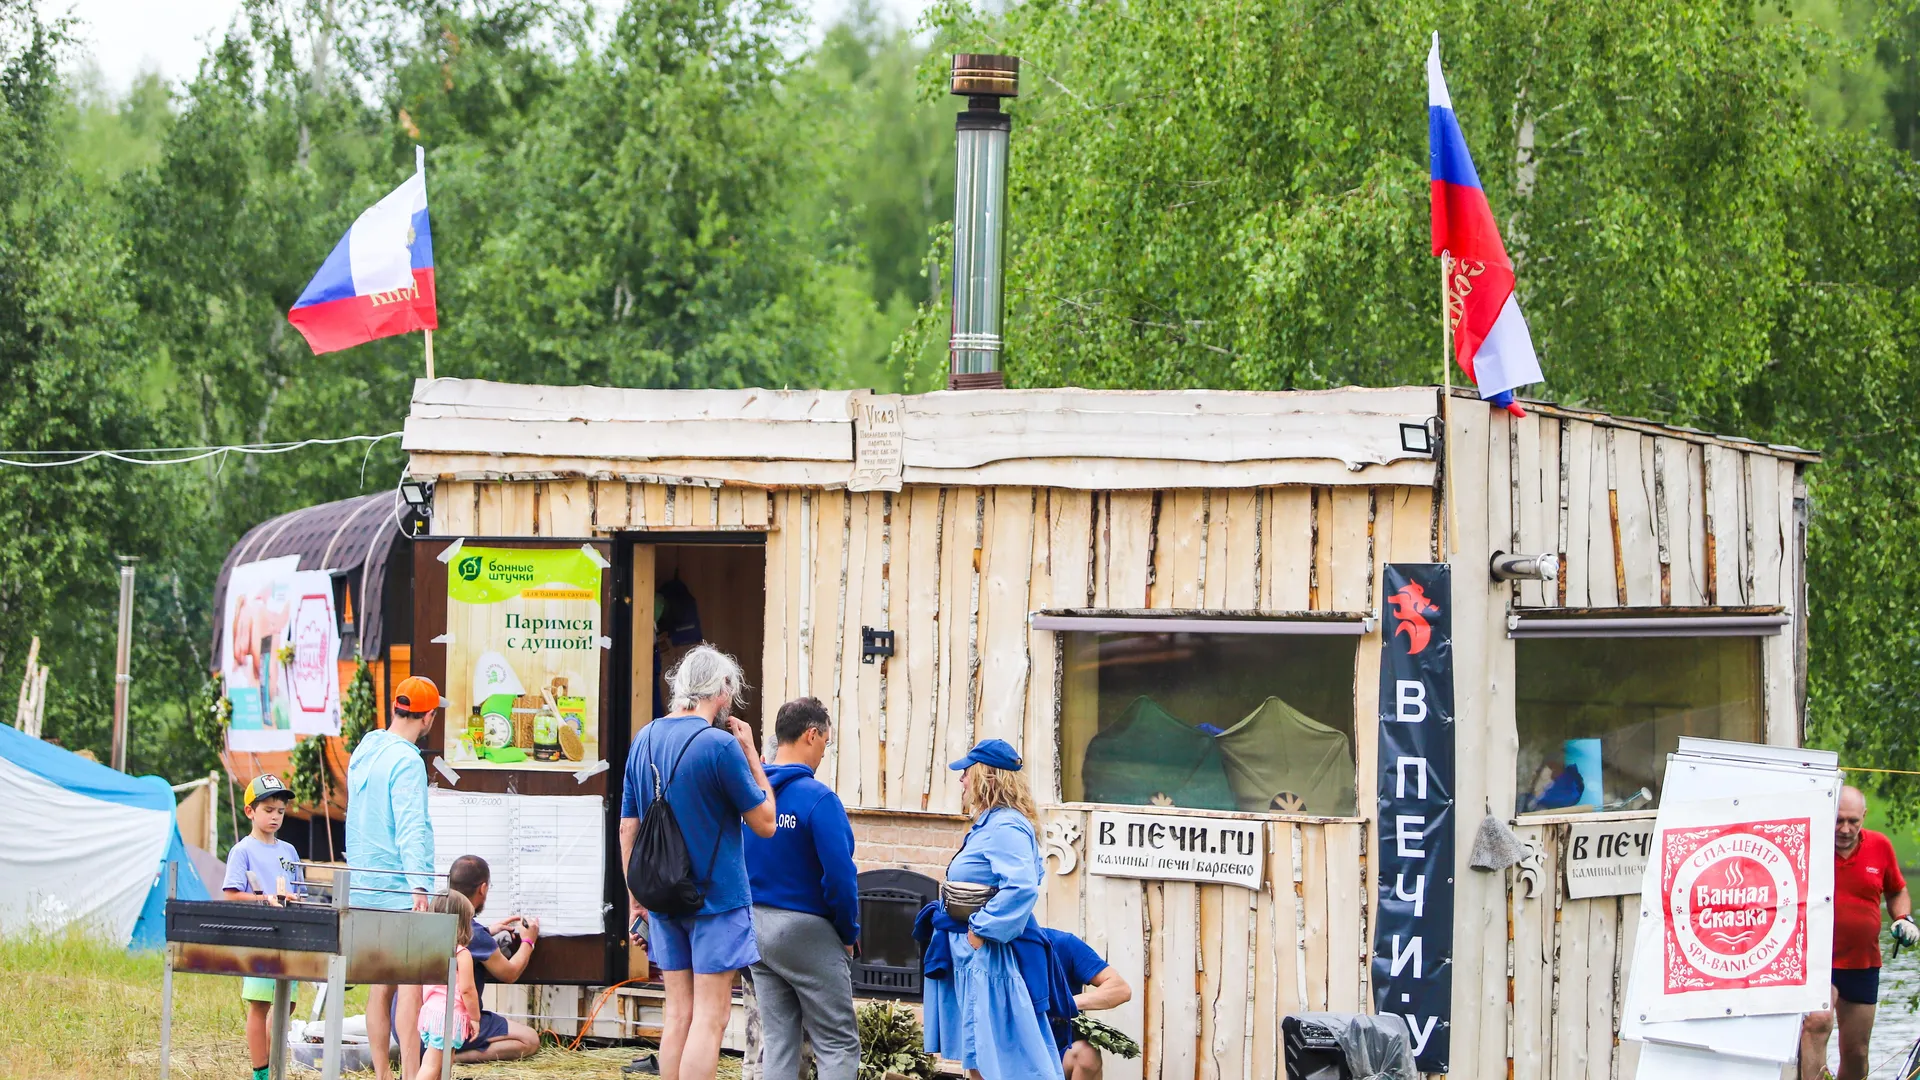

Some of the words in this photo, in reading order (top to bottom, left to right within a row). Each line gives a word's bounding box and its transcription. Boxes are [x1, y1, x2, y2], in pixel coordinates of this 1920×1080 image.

[489, 558, 534, 572] банные
[489, 572, 534, 583] штучки
[506, 613, 593, 634] Паримся
[508, 637, 516, 649] с
[522, 635, 593, 653] душой!
[1395, 679, 1427, 723] В
[1100, 821, 1116, 846] В
[1572, 836, 1589, 860] В
[1693, 839, 1779, 868] СПА-ЦЕНТР
[1696, 885, 1769, 907] Банная
[1699, 908, 1768, 929] Сказка
[1688, 937, 1779, 972] SPA-BANI.COM
